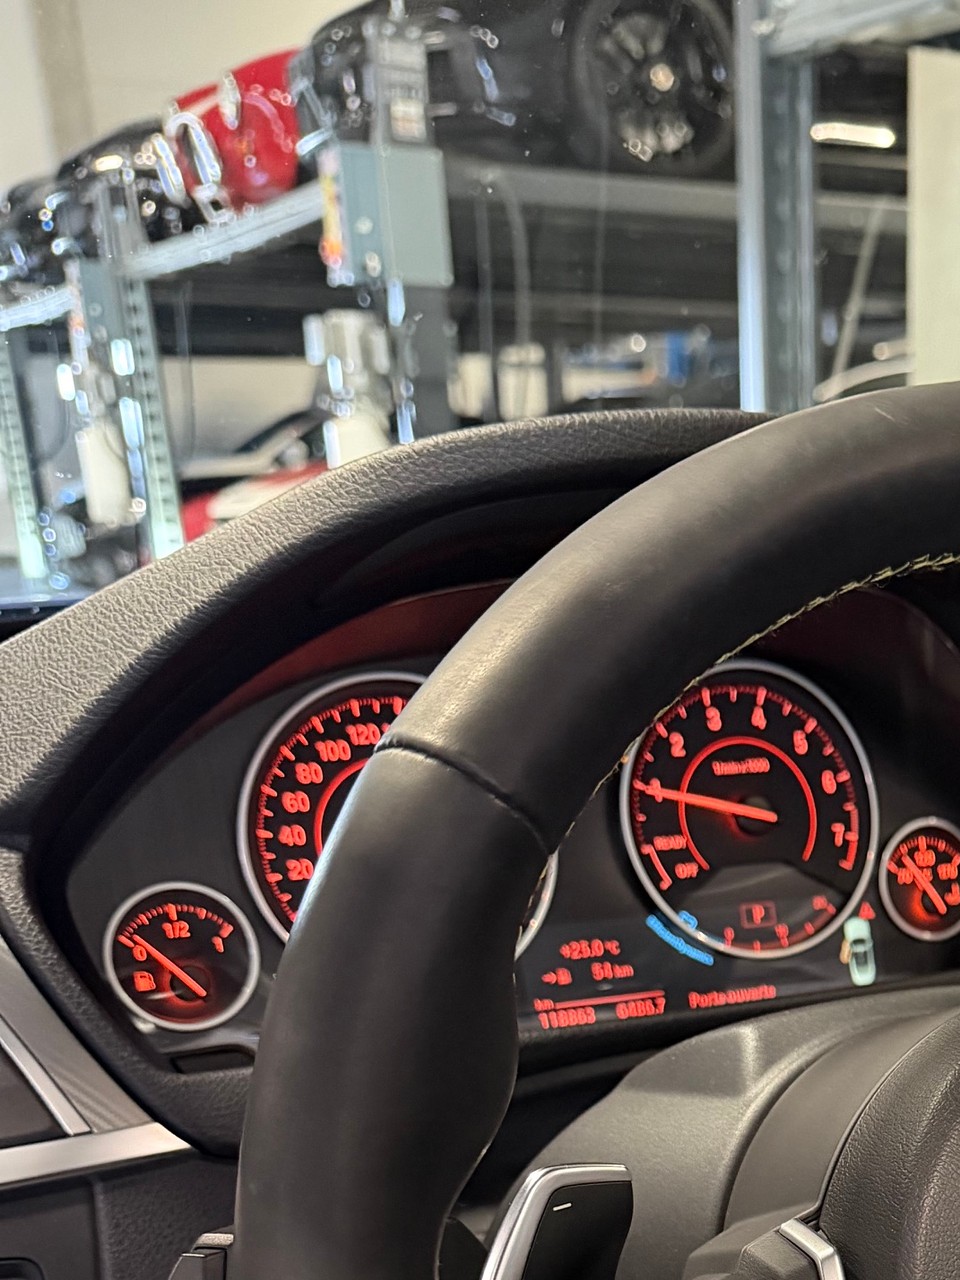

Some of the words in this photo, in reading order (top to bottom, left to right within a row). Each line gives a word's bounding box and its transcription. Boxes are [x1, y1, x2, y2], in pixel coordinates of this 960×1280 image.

[705, 706, 722, 732] 3
[751, 706, 767, 730] 4
[345, 723, 380, 745] 120
[669, 731, 686, 757] 2
[793, 729, 808, 755] 5
[314, 739, 351, 762] 100
[294, 762, 323, 784] 80
[821, 770, 837, 795] 6
[281, 791, 310, 813] 60
[278, 825, 307, 846] 40
[831, 822, 845, 847] 7
[286, 858, 314, 881] 20
[752, 904, 765, 926] P
[162, 920, 191, 939] 1/2
[132, 944, 147, 962] 0
[211, 936, 224, 953] 1
[613, 964, 634, 978] km
